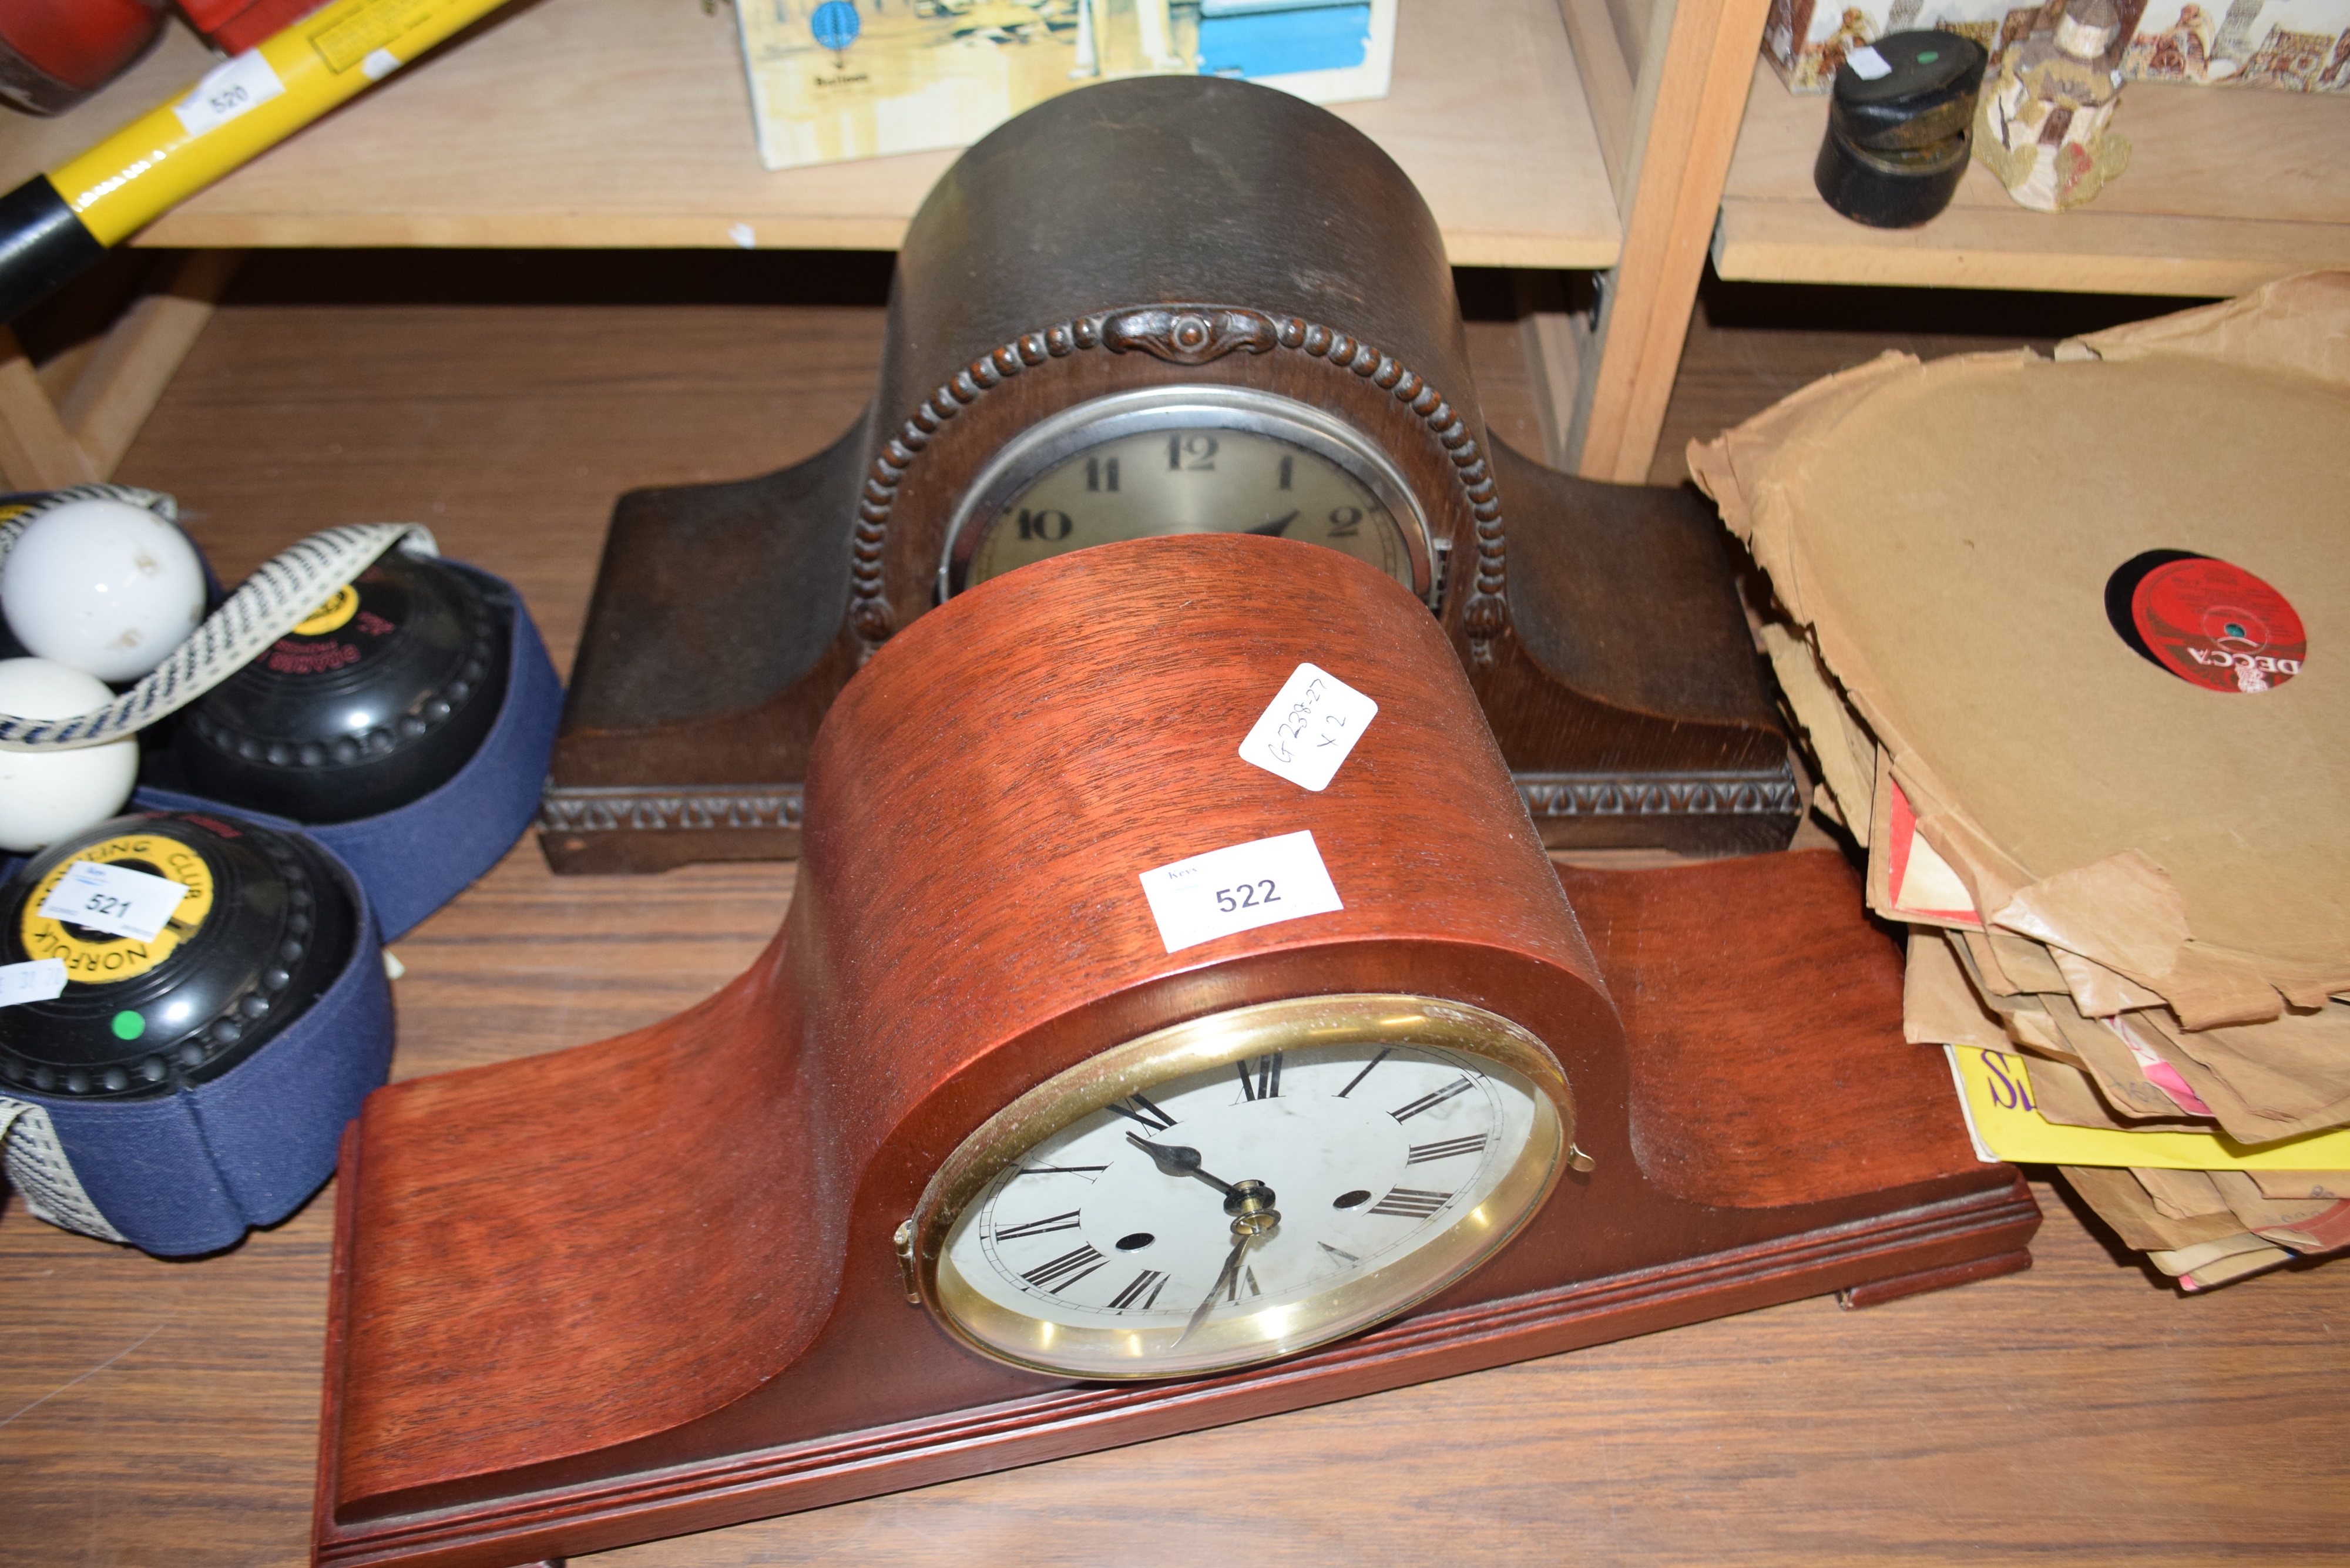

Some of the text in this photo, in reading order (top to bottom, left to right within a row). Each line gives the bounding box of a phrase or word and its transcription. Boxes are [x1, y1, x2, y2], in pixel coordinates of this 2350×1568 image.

[211, 85, 249, 113] 520
[1165, 434, 1219, 471] 12
[1085, 456, 1120, 492] 11
[1278, 455, 1292, 490] 1
[1017, 508, 1073, 541] 10
[1327, 506, 1363, 537] 2
[2187, 647, 2302, 675] DECCA
[1168, 867, 1197, 880] Keys
[33, 923, 149, 971] NORFOLK
[167, 852, 201, 900] CLUB
[86, 894, 132, 918] 521
[1216, 879, 1281, 912] 522
[1228, 1052, 1287, 1106] XII
[1386, 1073, 1477, 1125] II
[1405, 1129, 1489, 1169] III
[1362, 1183, 1459, 1223] IIII
[995, 1207, 1082, 1244] IX
[1017, 1240, 1111, 1297] VIII
[1106, 1268, 1171, 1312] VII
